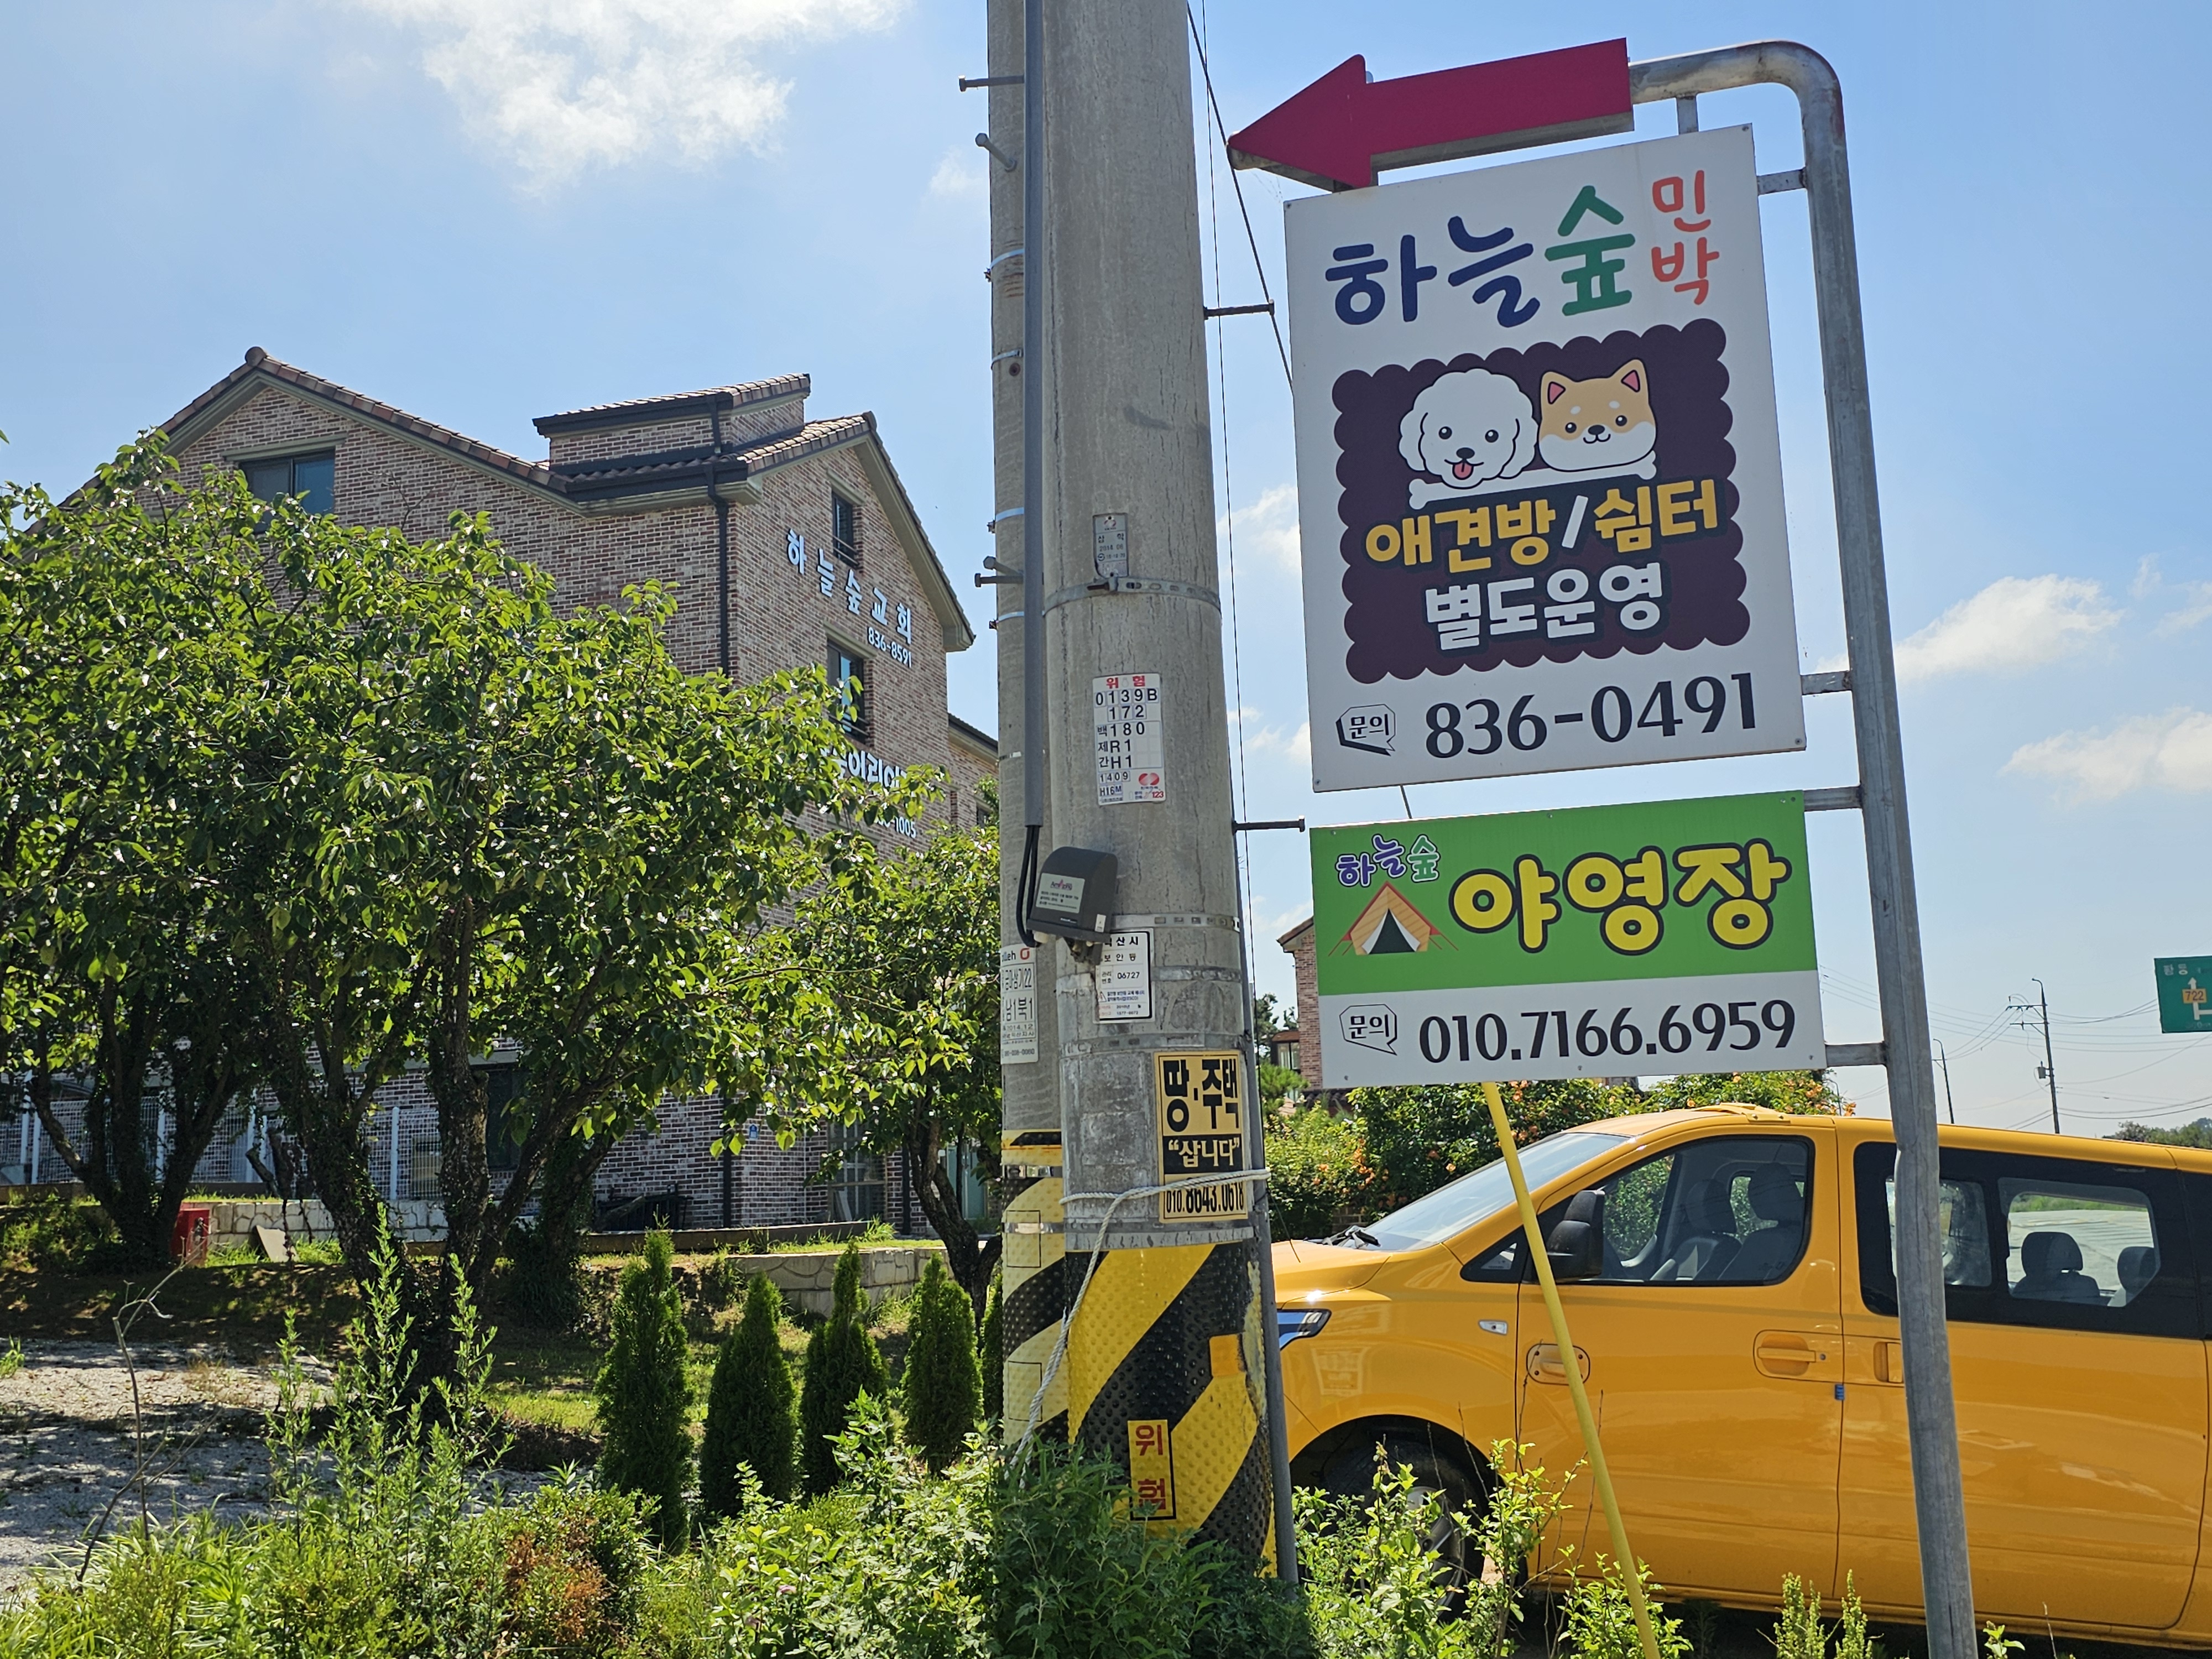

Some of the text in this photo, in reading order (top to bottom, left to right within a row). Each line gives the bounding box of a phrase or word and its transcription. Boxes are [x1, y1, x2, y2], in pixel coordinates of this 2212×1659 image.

[1326, 170, 1720, 327] 하늘숲 민박
[1426, 563, 1662, 651] 별도운영
[868, 627, 912, 668] 836-8591
[1095, 688, 1157, 706] 0139B
[1106, 676, 1145, 689] 위험
[1109, 705, 1144, 719] 172
[1348, 672, 1756, 758] 문의 836-0491
[1100, 771, 1128, 782] 1409
[1336, 834, 1440, 887] 하늘숲
[1449, 838, 1792, 955] 야영장
[2185, 990, 2204, 1001] 722
[1348, 1000, 1795, 1063] 문의 010.7166.6959
[1135, 1423, 1166, 1510] 위험
